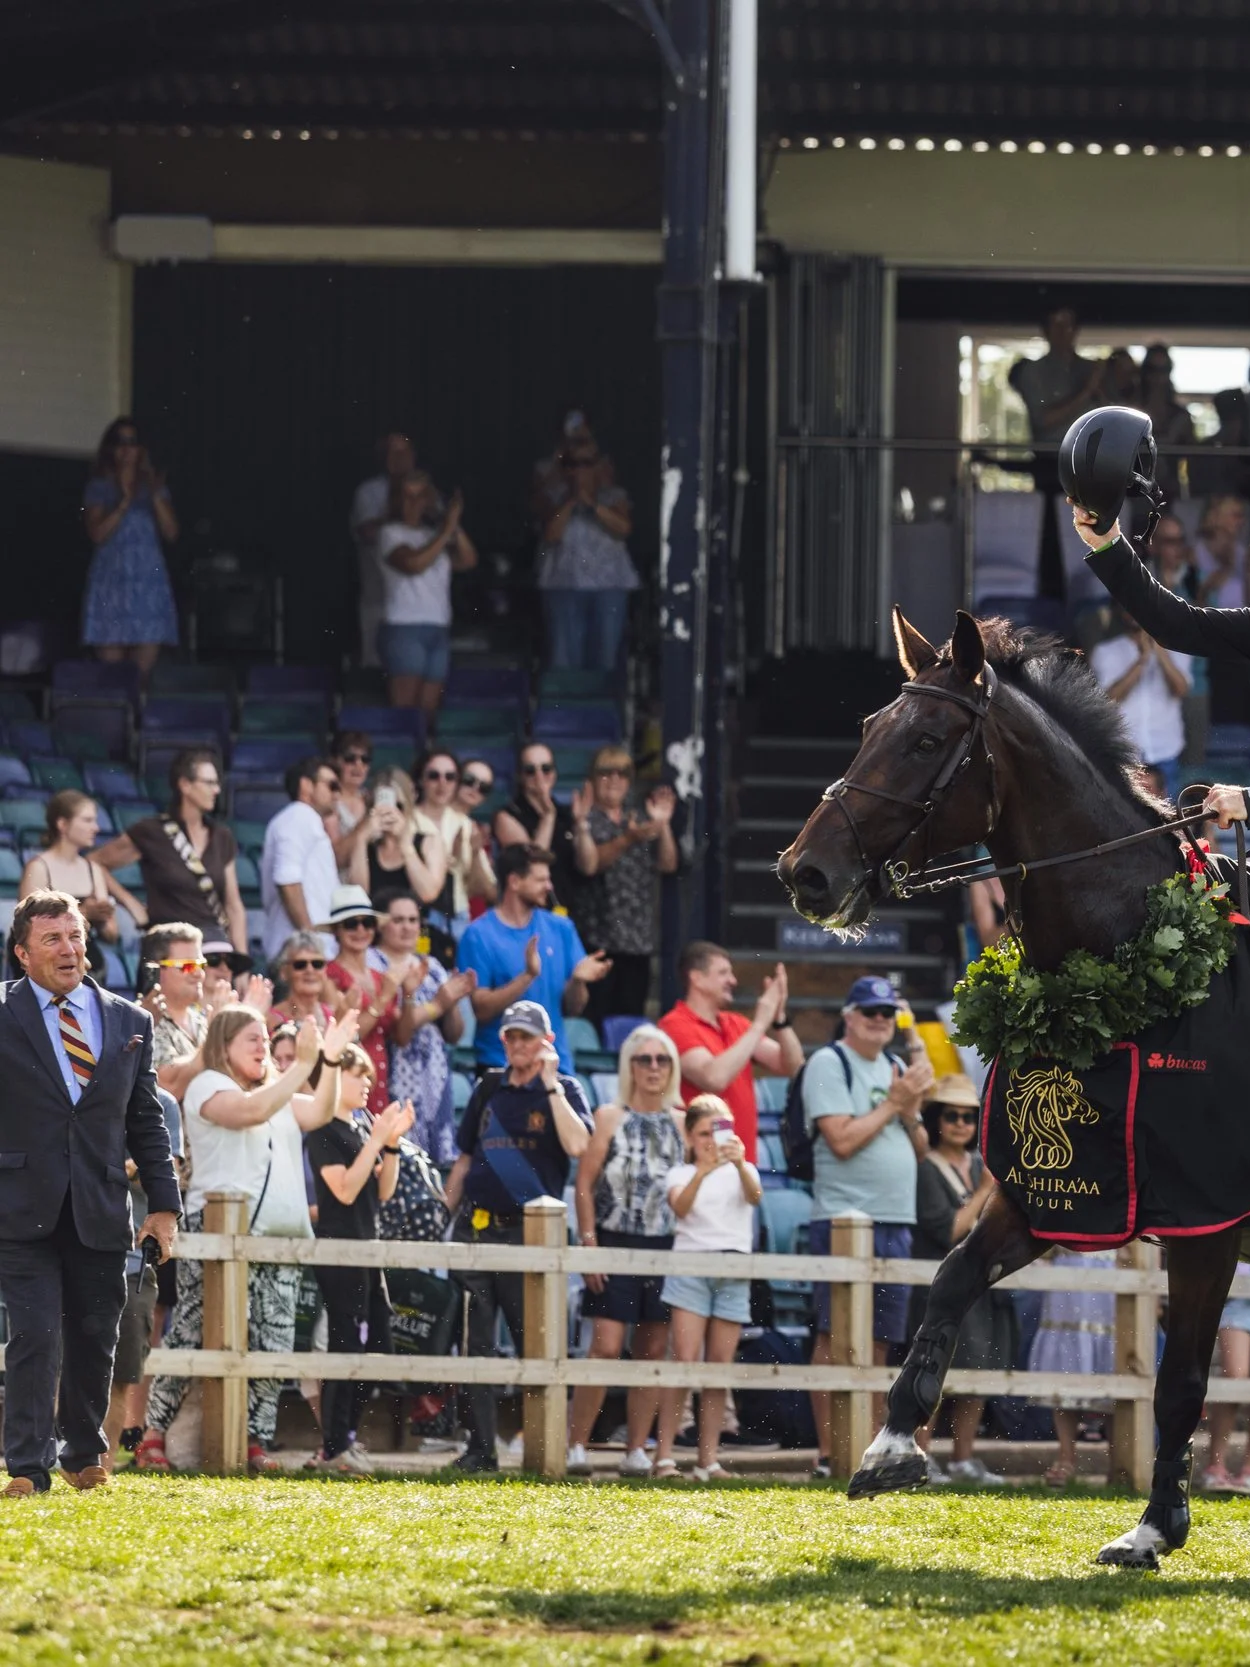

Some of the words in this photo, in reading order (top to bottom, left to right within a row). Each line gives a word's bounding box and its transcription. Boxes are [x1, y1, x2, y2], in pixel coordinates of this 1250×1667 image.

[1166, 1054, 1208, 1071] bucas
[1005, 1166, 1025, 1185] AL
[1026, 1191, 1074, 1211] TOUR
